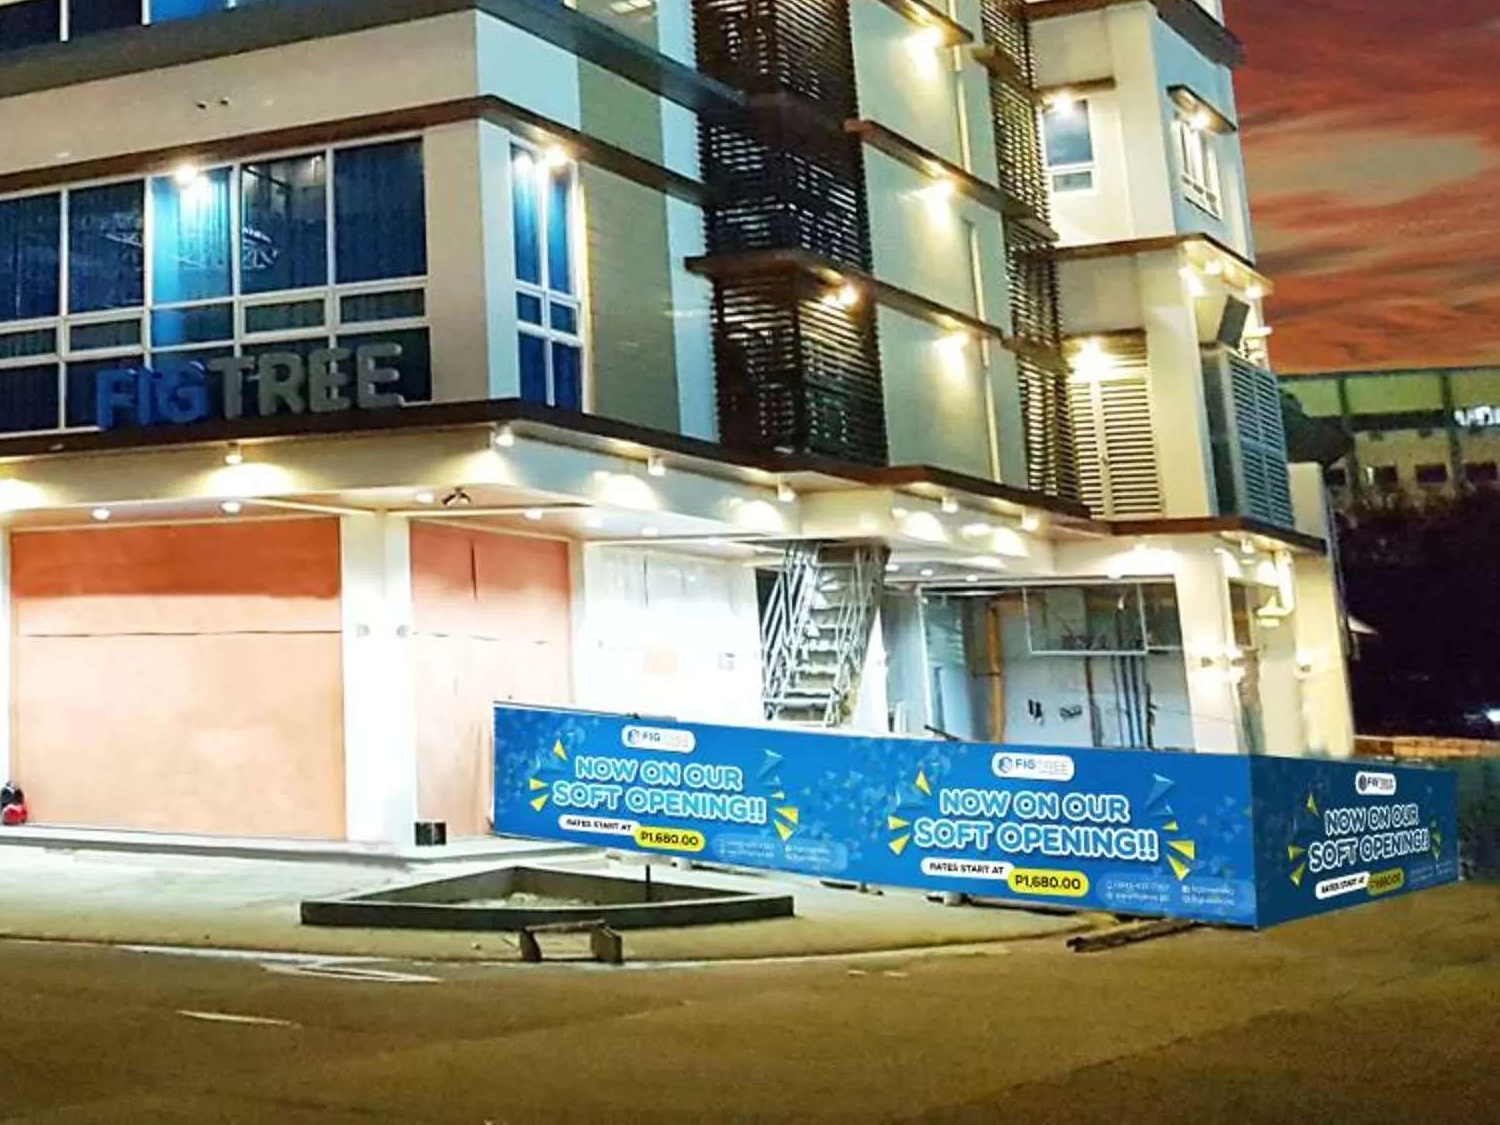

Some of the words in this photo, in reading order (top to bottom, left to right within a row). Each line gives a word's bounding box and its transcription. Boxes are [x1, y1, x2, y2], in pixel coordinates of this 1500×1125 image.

[575, 755, 638, 784] NOW
[640, 761, 682, 787] ON
[683, 763, 743, 791] OUR
[552, 780, 623, 810] SOFT
[625, 788, 767, 824] OPENING!!
[940, 788, 1011, 818] NOW
[1013, 791, 1060, 820] ON
[1061, 793, 1130, 824] OUR
[1324, 807, 1366, 836] NOW
[1367, 805, 1391, 830] ON
[1391, 803, 1420, 828] OUR
[914, 818, 995, 851] SOFT
[997, 824, 1160, 862] OPENING!!
[1308, 838, 1358, 872] SOFT
[960, 864, 990, 874] START
[992, 866, 1004, 875] AT
